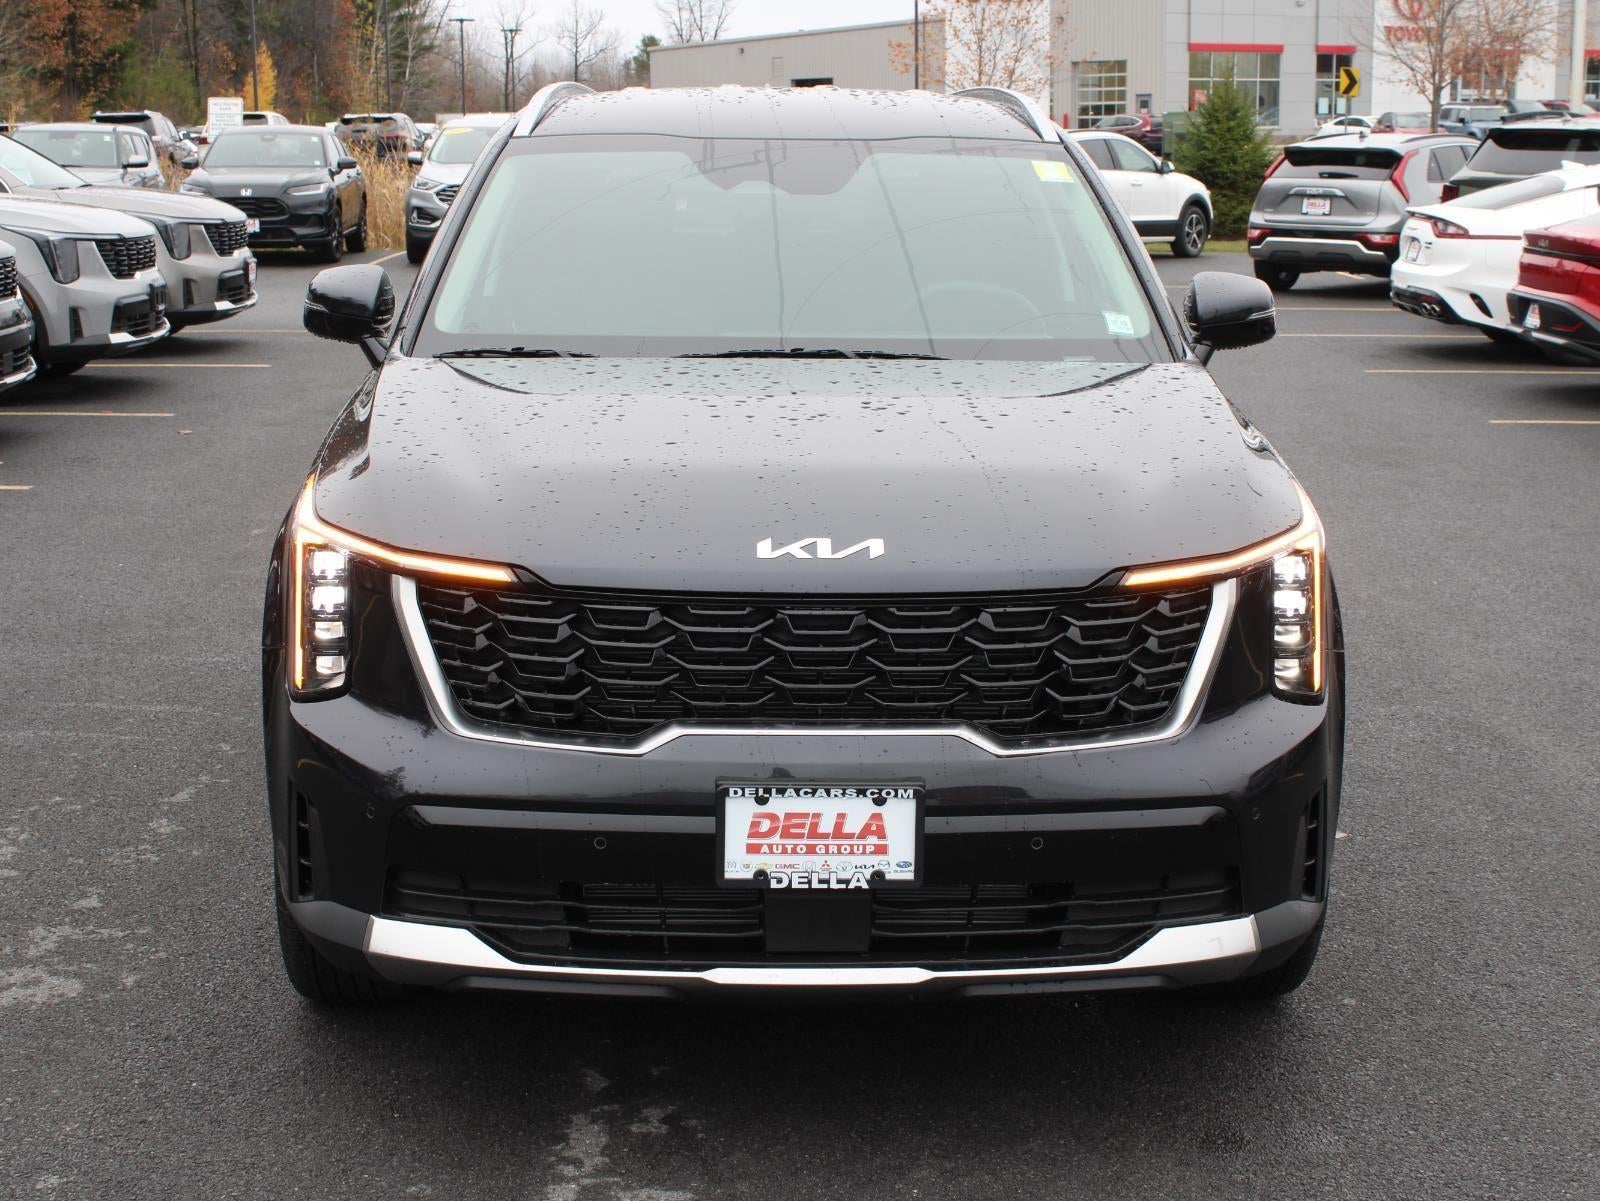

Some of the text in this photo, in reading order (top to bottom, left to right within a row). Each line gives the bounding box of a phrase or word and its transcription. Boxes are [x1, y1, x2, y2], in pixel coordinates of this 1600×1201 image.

[756, 537, 885, 560] KIA
[728, 787, 914, 799] DELLACARS.COM
[746, 812, 888, 840] DELLA
[760, 844, 876, 854] AUTO GROUP
[769, 871, 870, 889] DELLA
